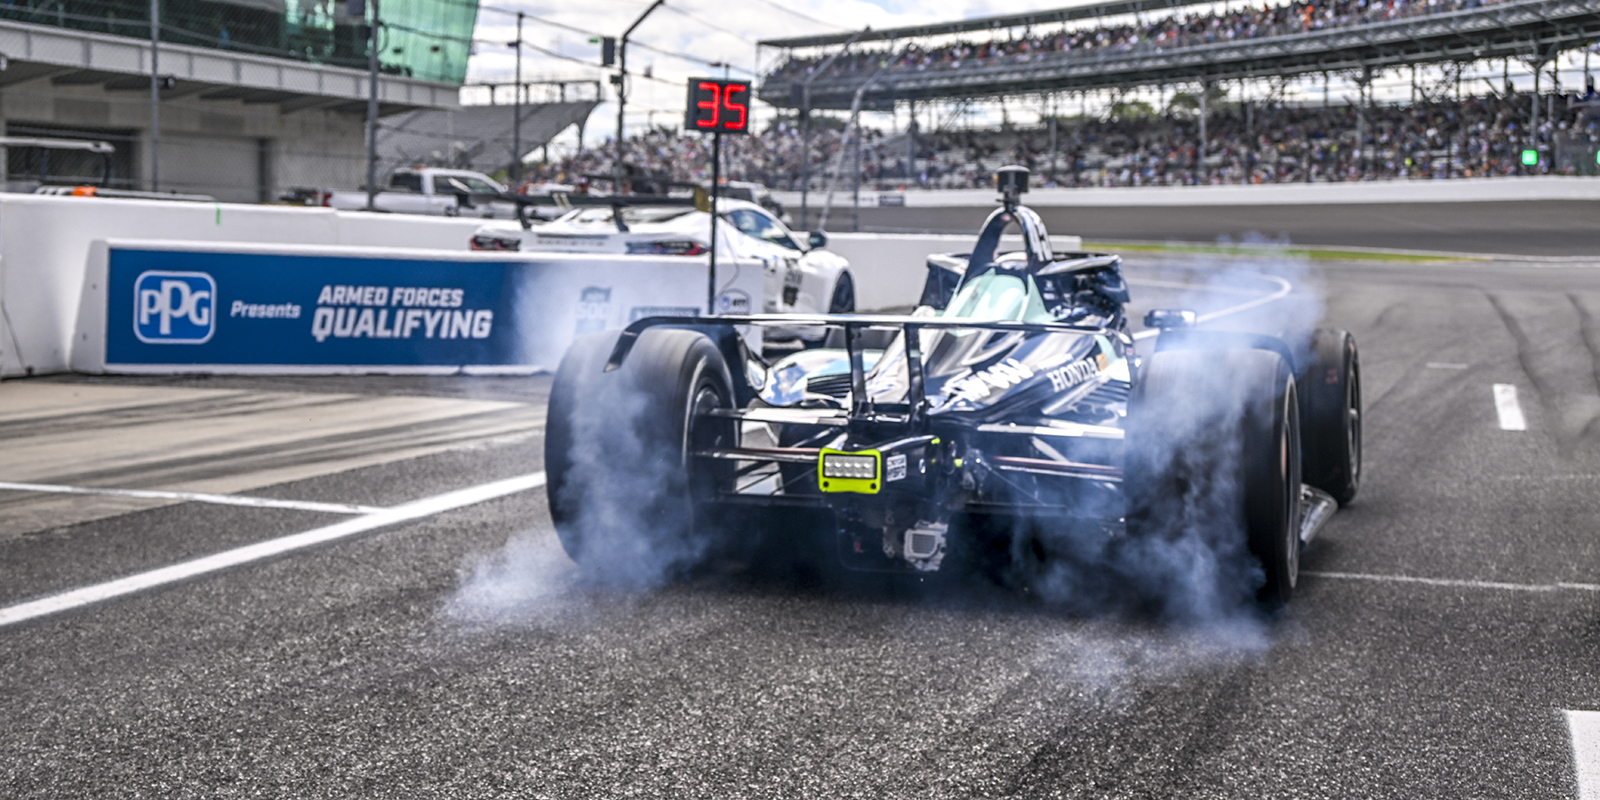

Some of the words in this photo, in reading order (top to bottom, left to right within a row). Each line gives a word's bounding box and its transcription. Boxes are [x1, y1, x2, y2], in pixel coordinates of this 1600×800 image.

[697, 82, 747, 130] 35
[140, 279, 210, 335] PPG
[230, 300, 302, 319] Presents
[316, 284, 389, 307] ARMED
[391, 287, 464, 307] FORCES
[311, 306, 493, 342] QUALIFYING
[1047, 357, 1100, 392] HONDA
